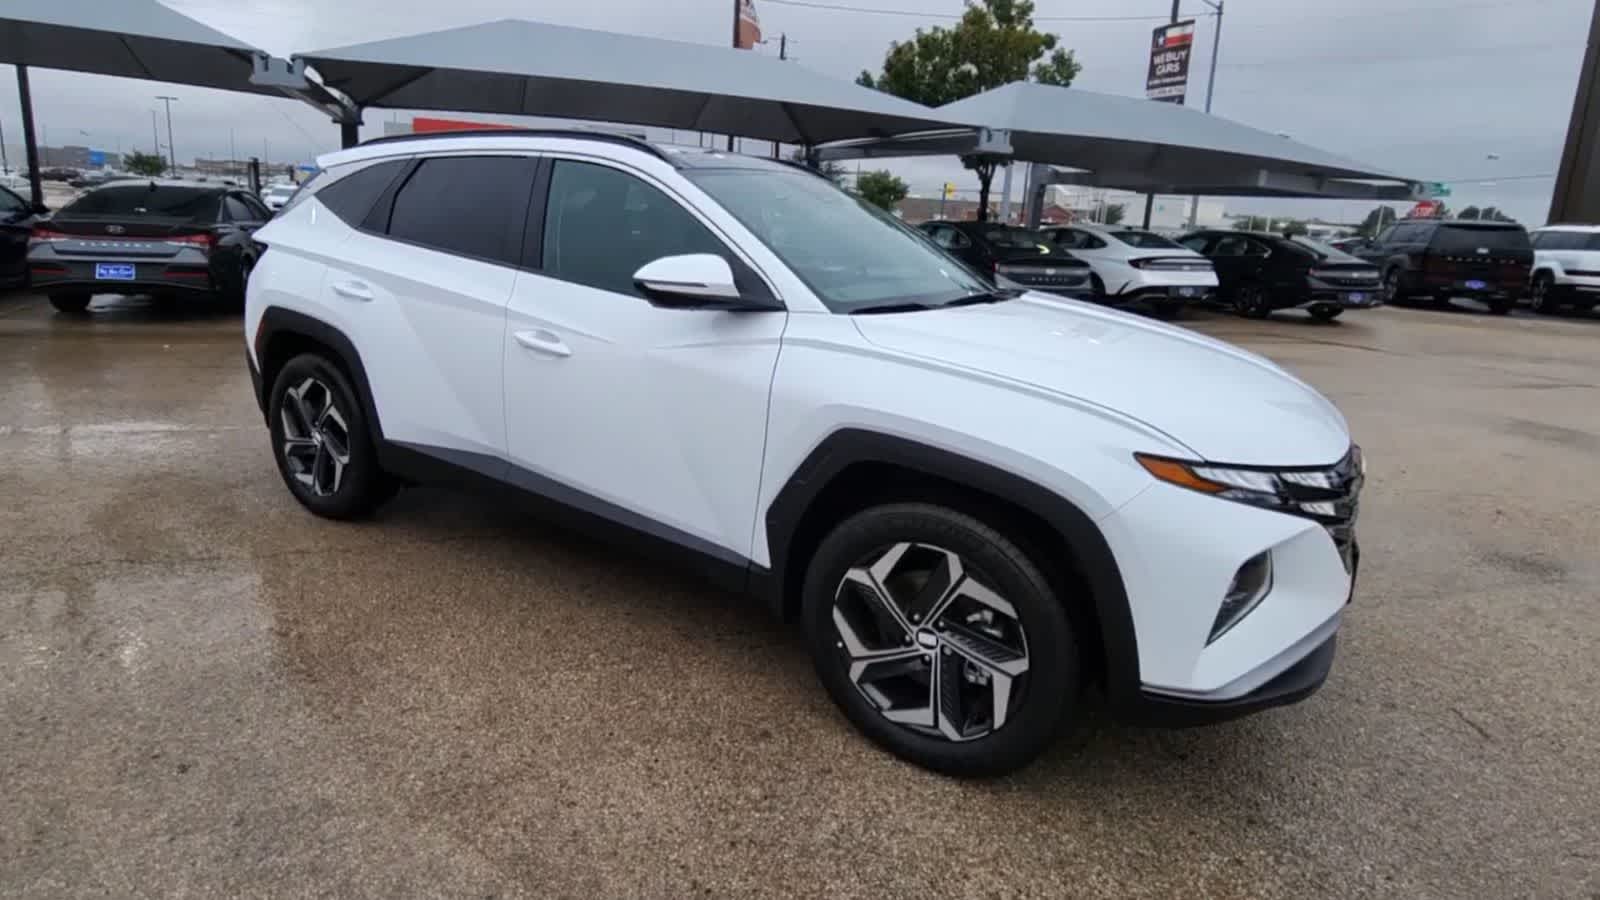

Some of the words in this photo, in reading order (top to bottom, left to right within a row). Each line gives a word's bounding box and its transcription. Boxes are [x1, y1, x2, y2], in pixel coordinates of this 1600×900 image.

[1153, 54, 1165, 65] WE
[1166, 50, 1187, 61] BUY
[1155, 62, 1180, 75] CARS
